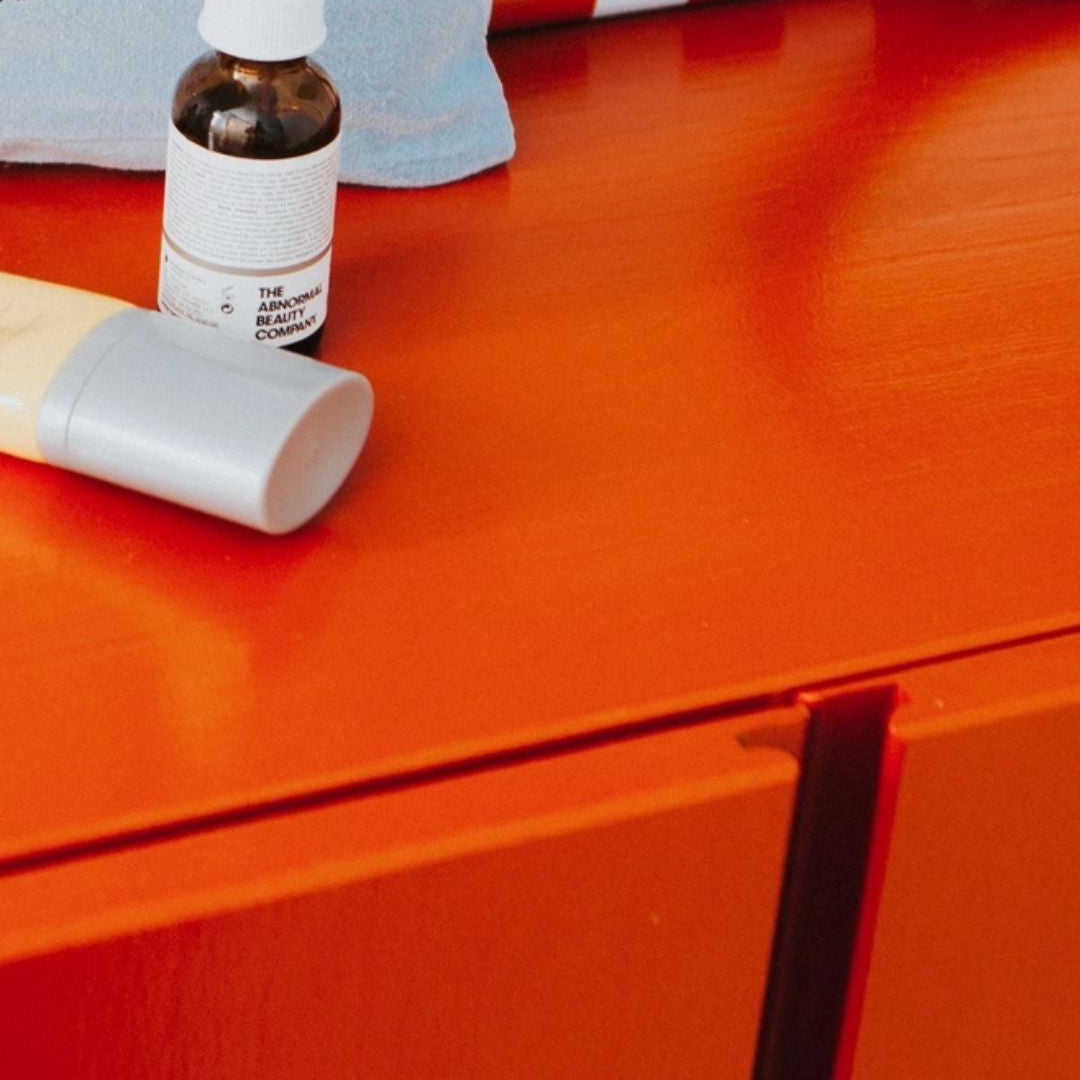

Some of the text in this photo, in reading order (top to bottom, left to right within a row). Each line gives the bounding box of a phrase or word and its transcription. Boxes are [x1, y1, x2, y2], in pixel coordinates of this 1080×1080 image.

[259, 285, 284, 299] THE
[255, 307, 306, 327] BEAUTY
[255, 314, 317, 340] COMPANY
